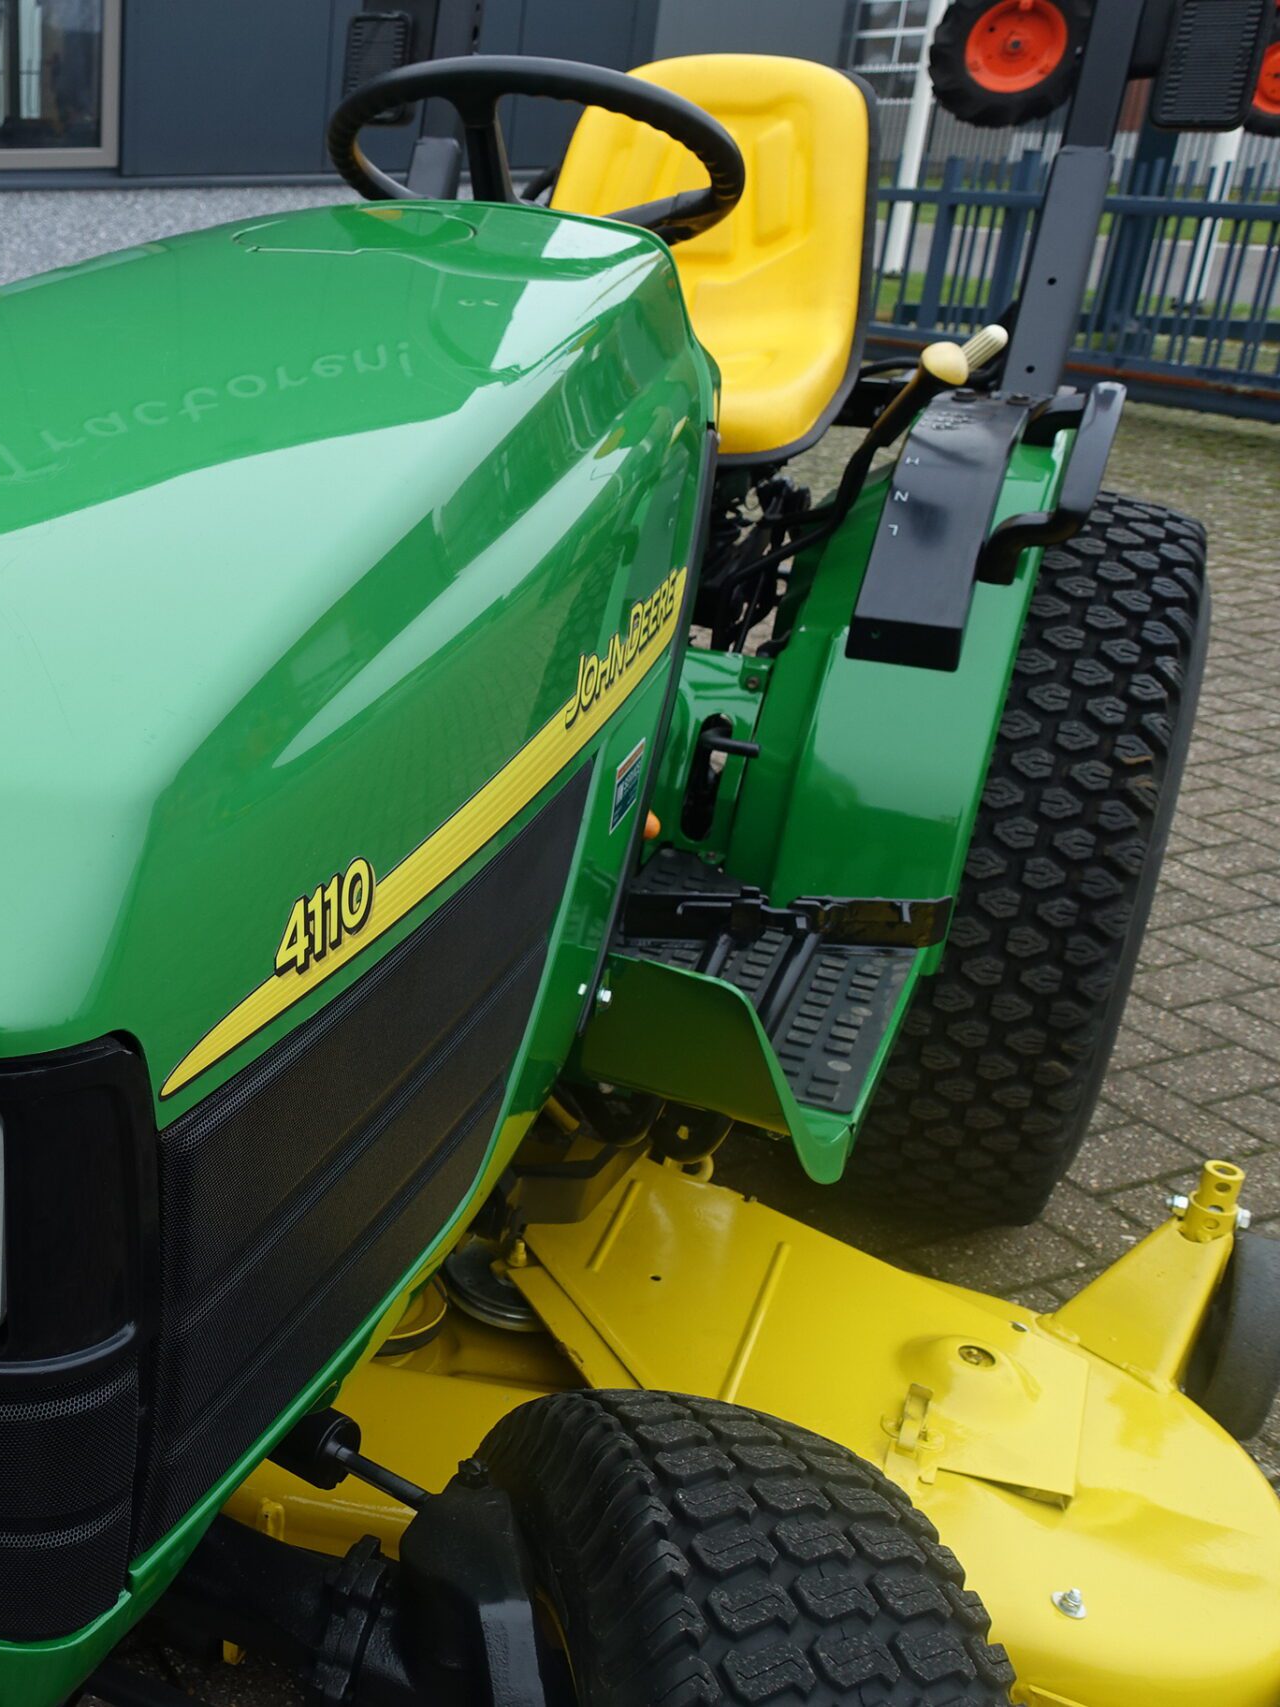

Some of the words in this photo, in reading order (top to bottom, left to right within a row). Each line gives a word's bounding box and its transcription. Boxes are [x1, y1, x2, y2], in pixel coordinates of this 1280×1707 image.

[564, 631, 625, 730] JOHN
[625, 568, 678, 668] DEERE
[274, 856, 375, 977] 4110
